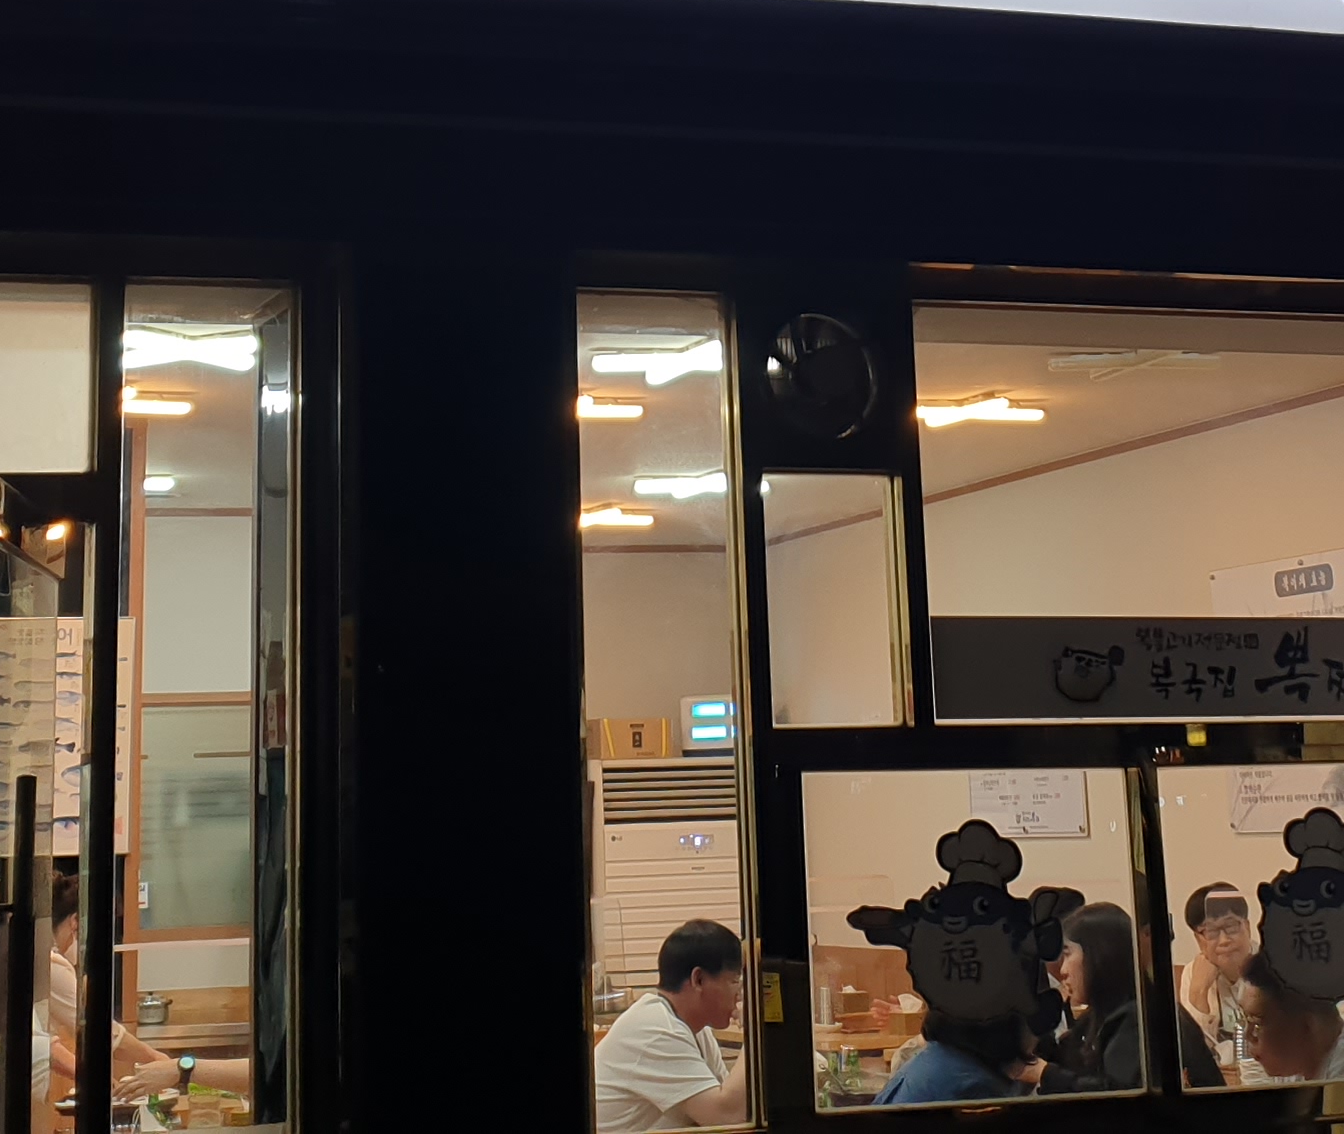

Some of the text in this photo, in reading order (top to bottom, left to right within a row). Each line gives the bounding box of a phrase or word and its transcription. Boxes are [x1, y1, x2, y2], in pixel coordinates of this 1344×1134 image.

[1148, 655, 1237, 702] 복국집
[940, 939, 983, 985] 福
[1291, 923, 1333, 965] 福
